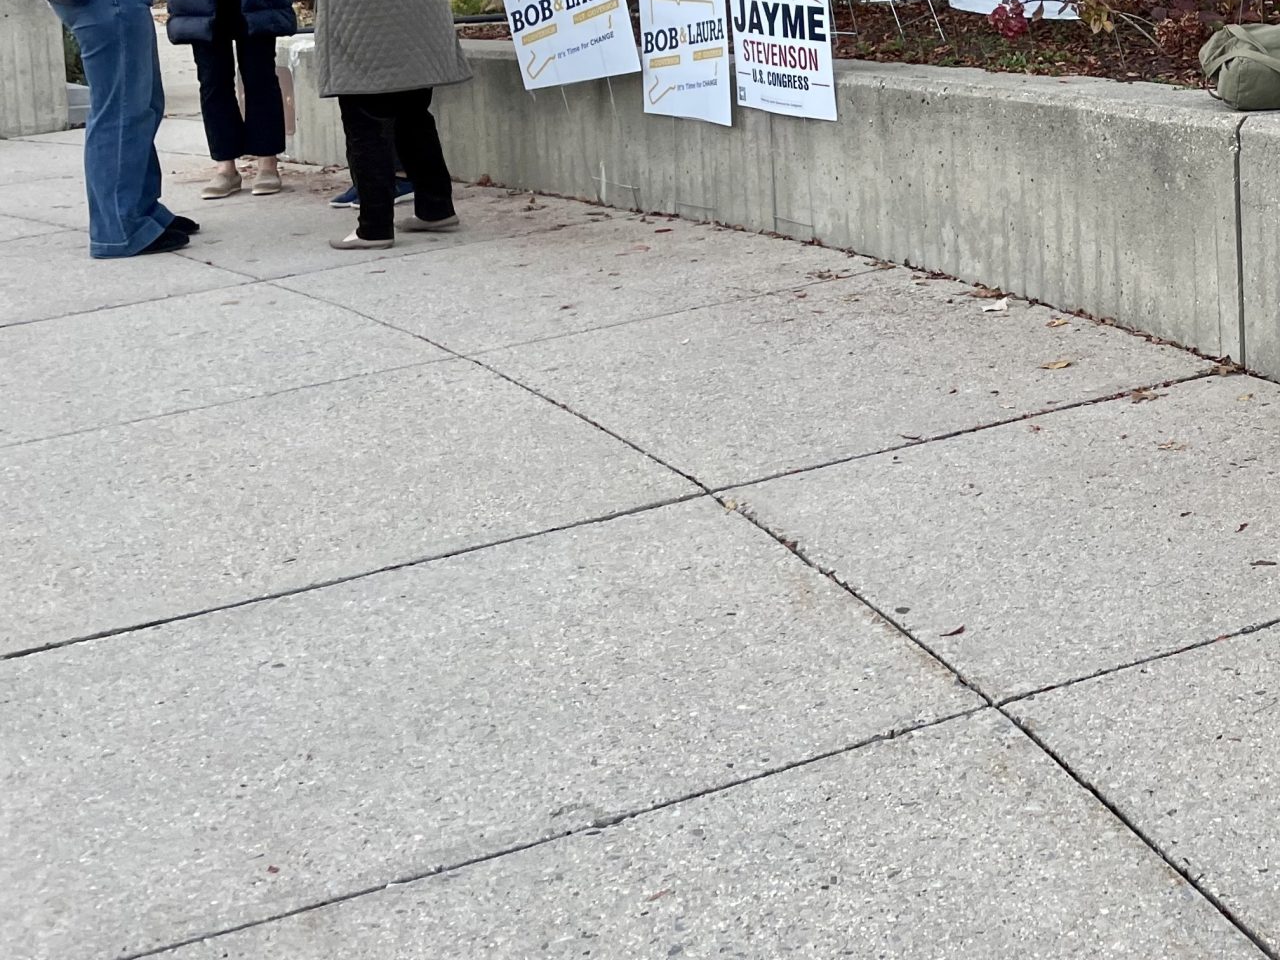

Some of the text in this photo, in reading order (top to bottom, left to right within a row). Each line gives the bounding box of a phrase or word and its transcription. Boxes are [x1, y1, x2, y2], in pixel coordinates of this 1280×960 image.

[566, 44, 580, 56] Time
[580, 41, 589, 50] for
[589, 31, 614, 46] CHANGE
[643, 27, 679, 54] BOB
[687, 18, 724, 45] LAURA
[743, 39, 819, 71] STEVENSON
[752, 68, 810, 91] U.S. CONGRESS
